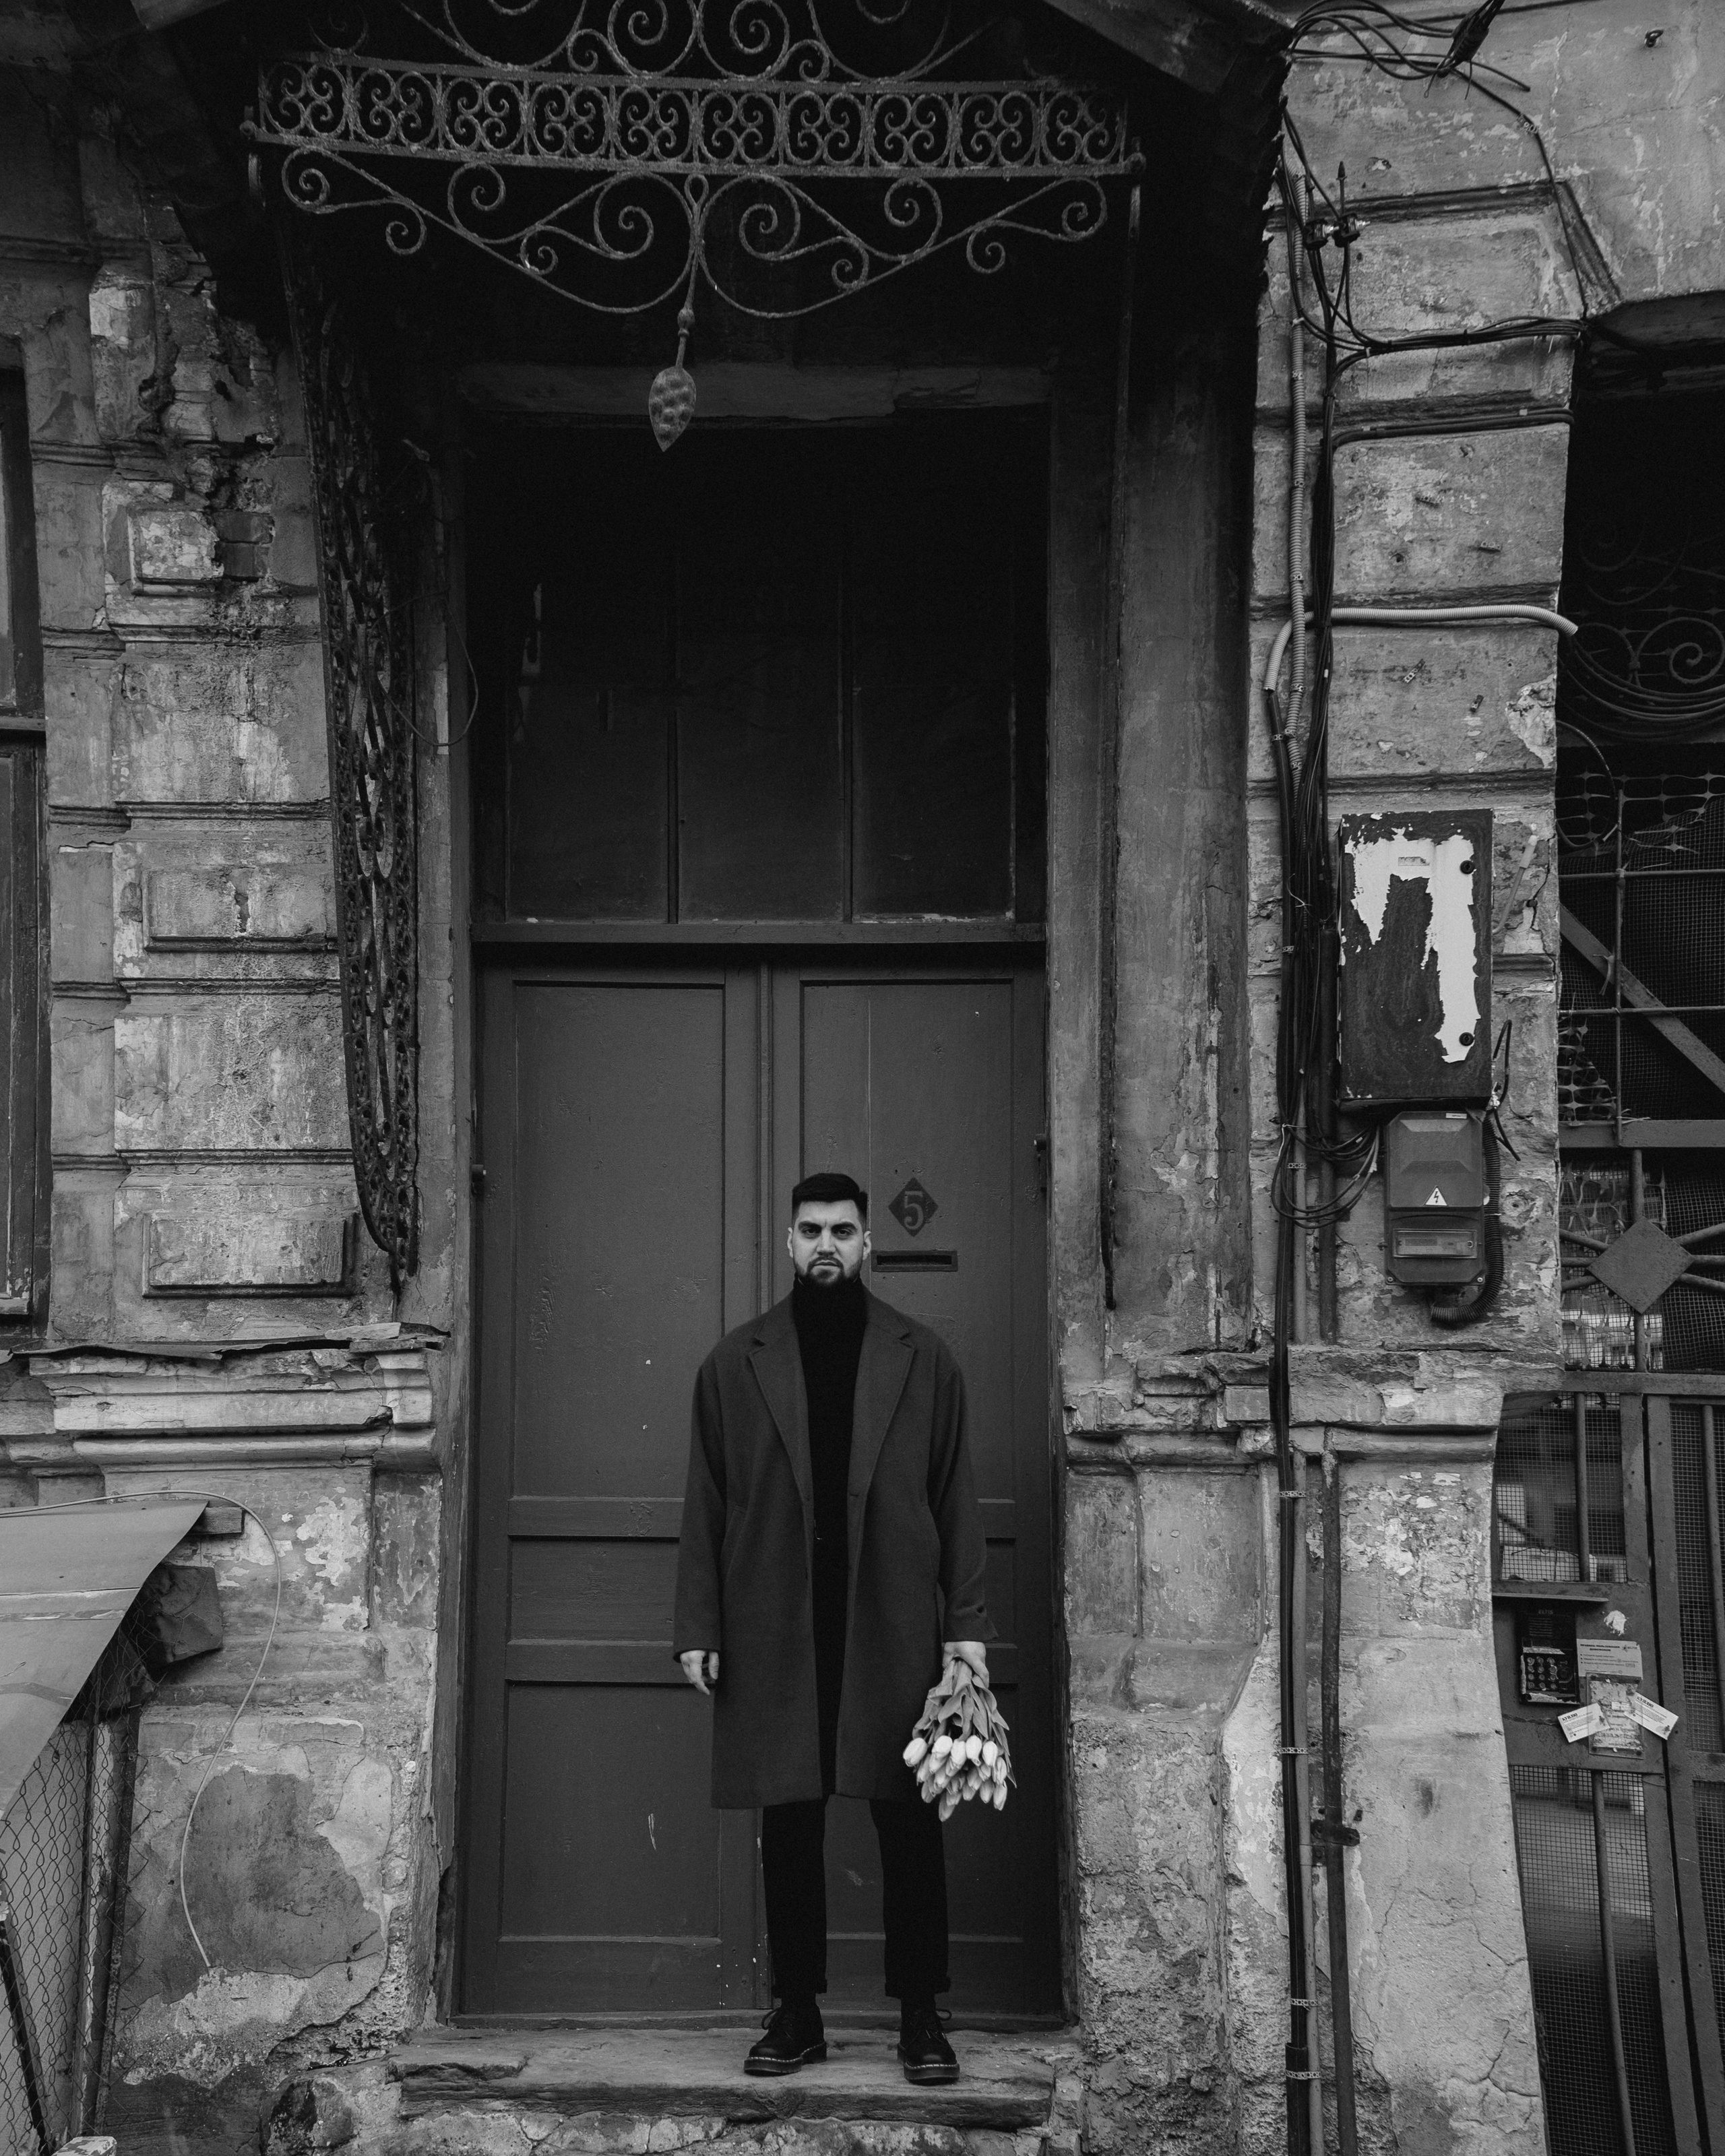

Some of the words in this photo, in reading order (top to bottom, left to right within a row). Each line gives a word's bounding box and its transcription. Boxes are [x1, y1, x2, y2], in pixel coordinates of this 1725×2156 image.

[904, 1191, 924, 1230] 5
[1636, 1696, 1654, 1707] КУПЛЮ
[1561, 1713, 1578, 1721] КУПЛЮ
